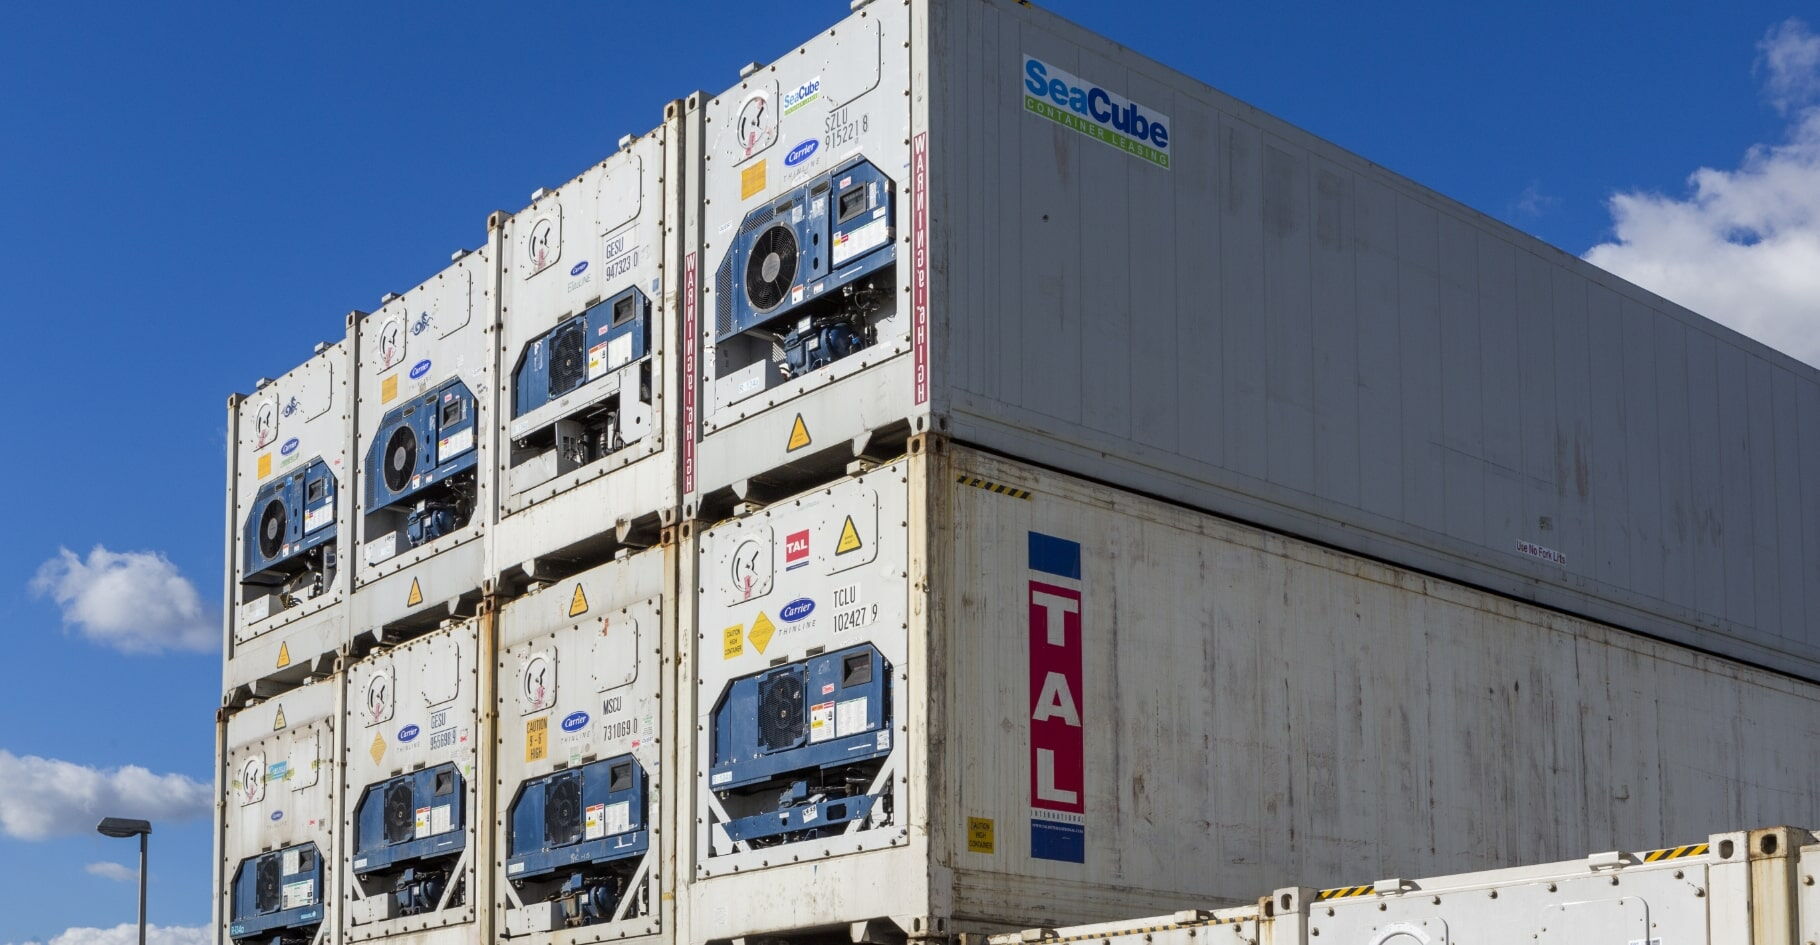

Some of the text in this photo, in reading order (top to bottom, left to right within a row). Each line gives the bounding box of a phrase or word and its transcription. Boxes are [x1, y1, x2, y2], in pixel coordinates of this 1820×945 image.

[784, 80, 820, 109] SeaCube
[1025, 59, 1169, 148] SeaCube
[824, 107, 848, 134] SZLU
[862, 114, 868, 133] 8
[1027, 98, 1168, 165] CONTAINER LEASING
[788, 142, 816, 163] Carrier
[606, 237, 624, 259] GESU
[606, 255, 631, 282] 947323
[786, 539, 808, 554] TAL
[1516, 540, 1528, 552] Use
[1529, 544, 1538, 555] No
[1539, 548, 1552, 560] Fork
[833, 585, 856, 609] TCLU
[784, 602, 811, 618] Carrier
[833, 604, 878, 633] 102427 9
[778, 619, 816, 637] THINLINE
[603, 696, 622, 715] MSCU
[1032, 590, 1082, 804] TAL
[430, 712, 446, 729] GESU
[526, 717, 548, 734] CAUTION
[565, 715, 587, 728] Carrier
[603, 719, 631, 742] 731069
[400, 728, 418, 740] Carrier
